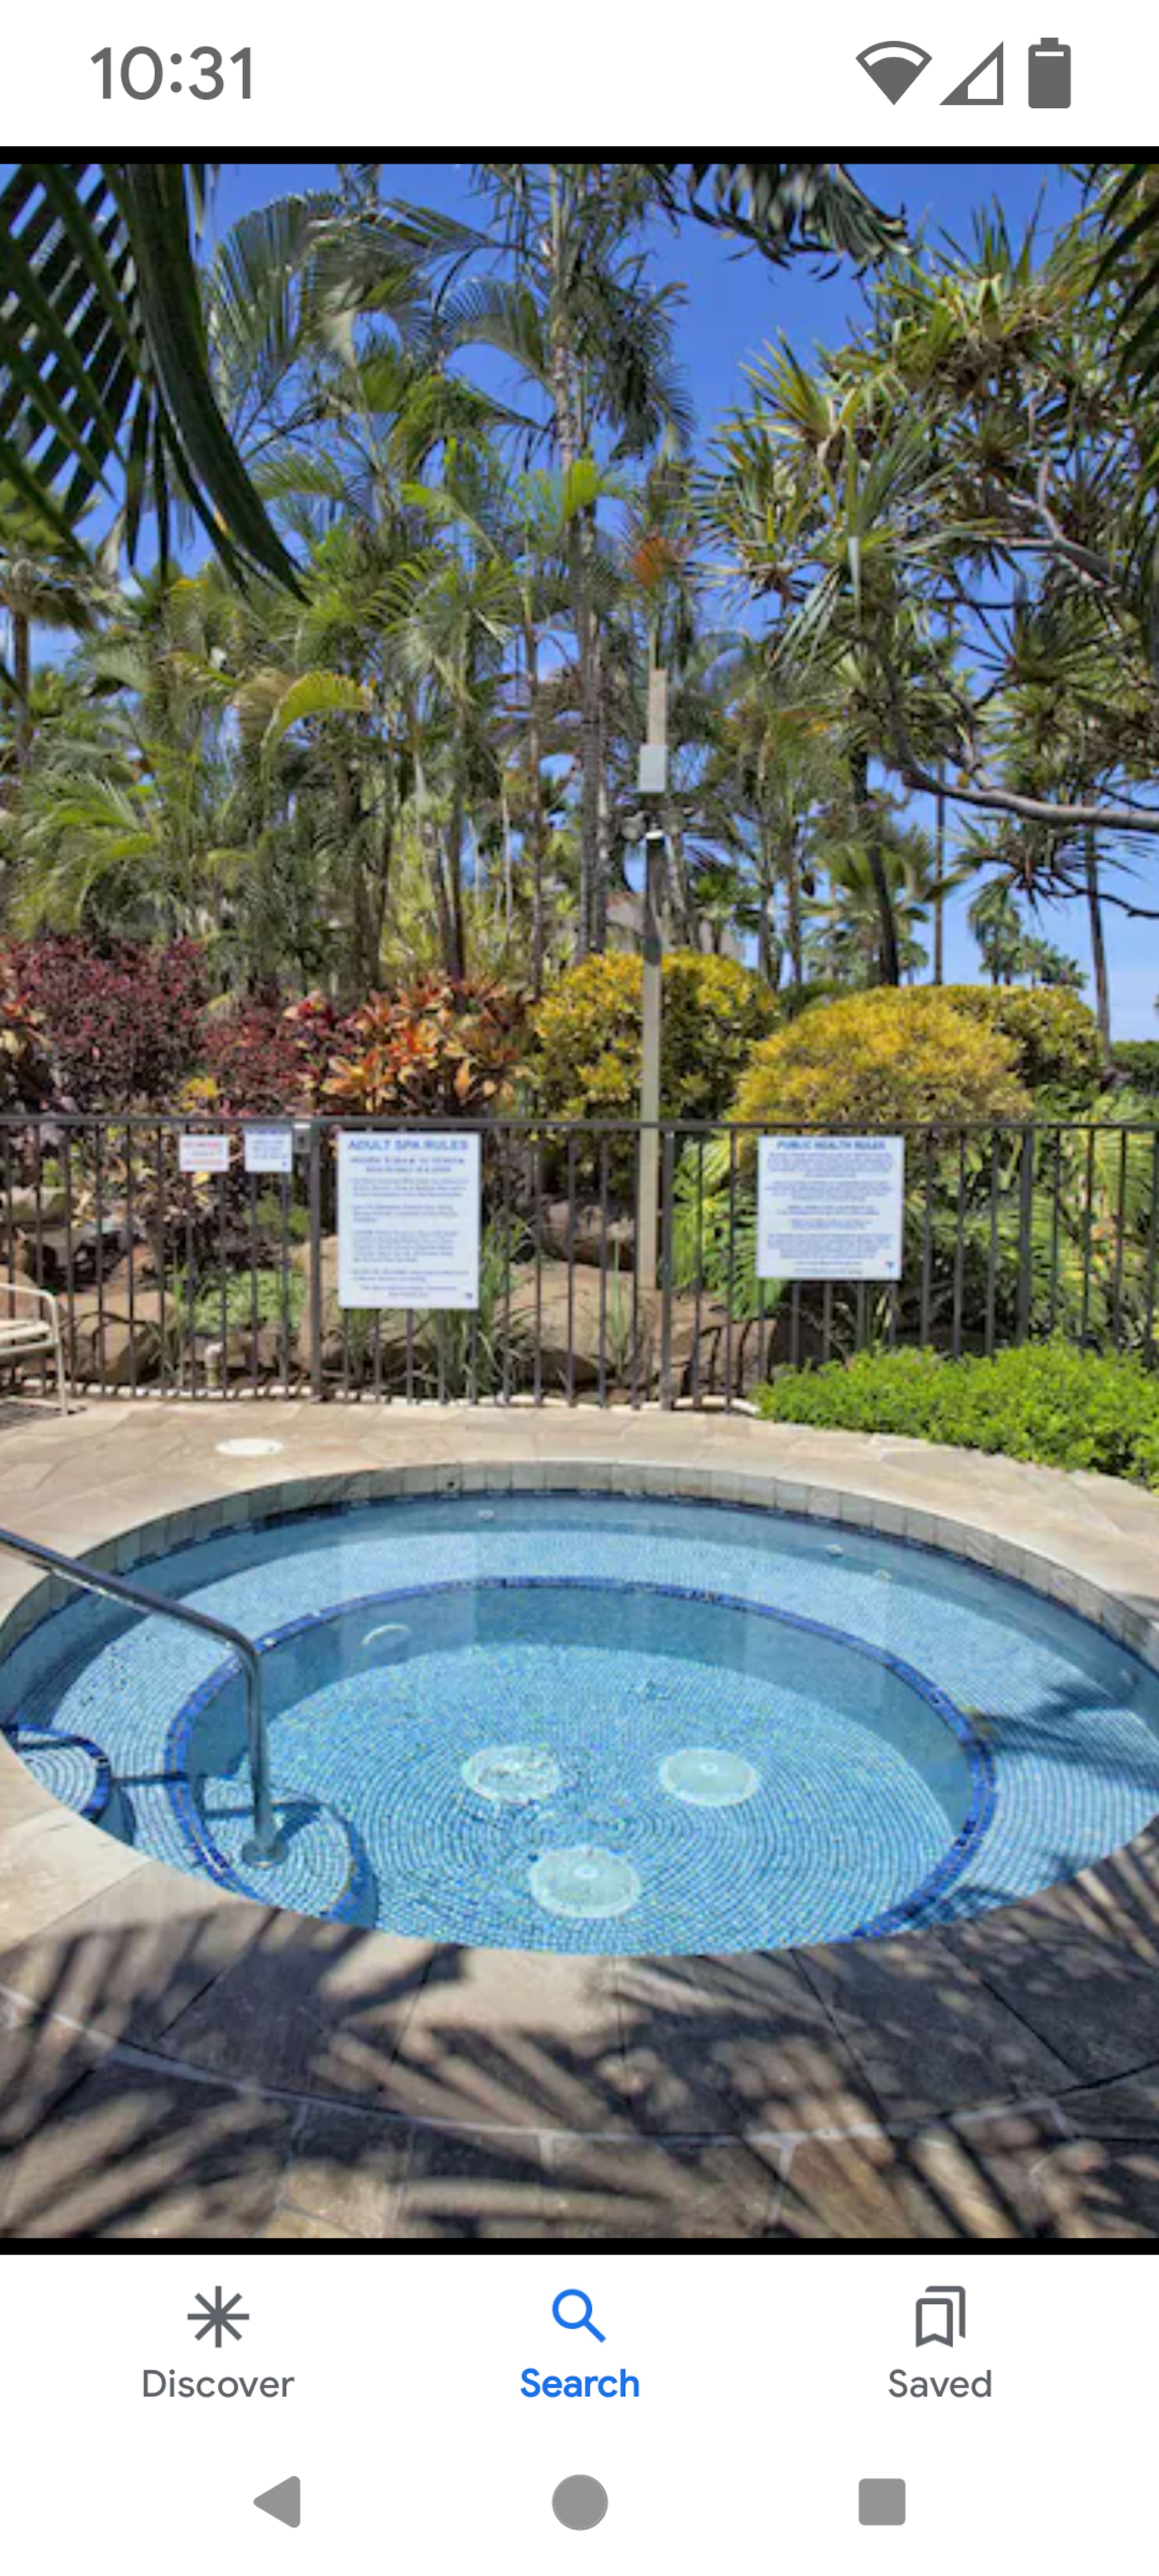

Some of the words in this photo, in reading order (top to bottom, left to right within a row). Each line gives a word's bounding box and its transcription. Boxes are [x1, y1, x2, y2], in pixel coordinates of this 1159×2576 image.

[91, 46, 250, 100] 10:31
[348, 1139, 390, 1150] ADULT
[394, 1139, 419, 1150] SPA
[424, 1139, 469, 1150] RULES
[777, 1140, 812, 1150] PUBLIC
[815, 1140, 852, 1150] HEALTH
[854, 1140, 886, 1150] RULES
[144, 2370, 294, 2398] Discover
[521, 2368, 639, 2398] Search
[889, 2369, 991, 2398] Saved
